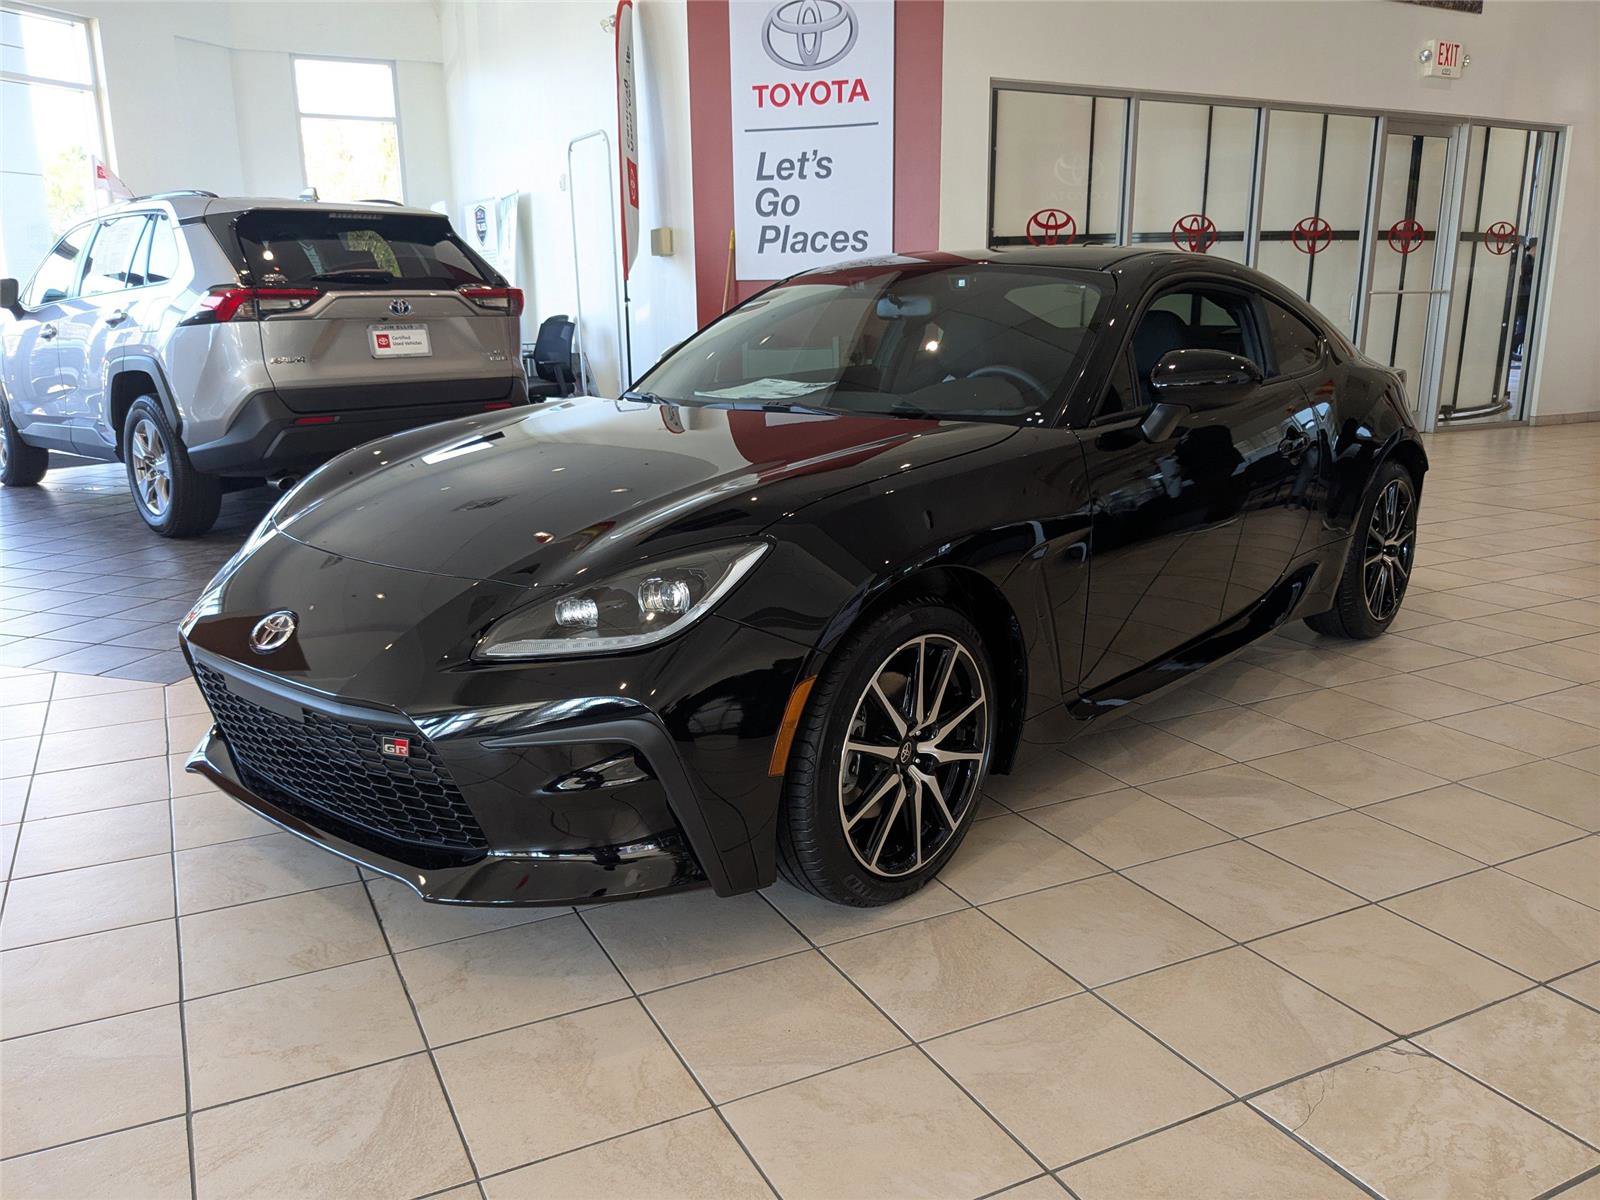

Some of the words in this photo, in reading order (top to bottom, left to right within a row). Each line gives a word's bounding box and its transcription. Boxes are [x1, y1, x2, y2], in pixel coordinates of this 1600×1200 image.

[1437, 42, 1460, 67] EXIT
[752, 79, 870, 108] TOYOTA
[756, 149, 833, 181] Let's
[755, 187, 800, 218] Go
[758, 225, 869, 254] Places
[384, 743, 407, 754] GR
